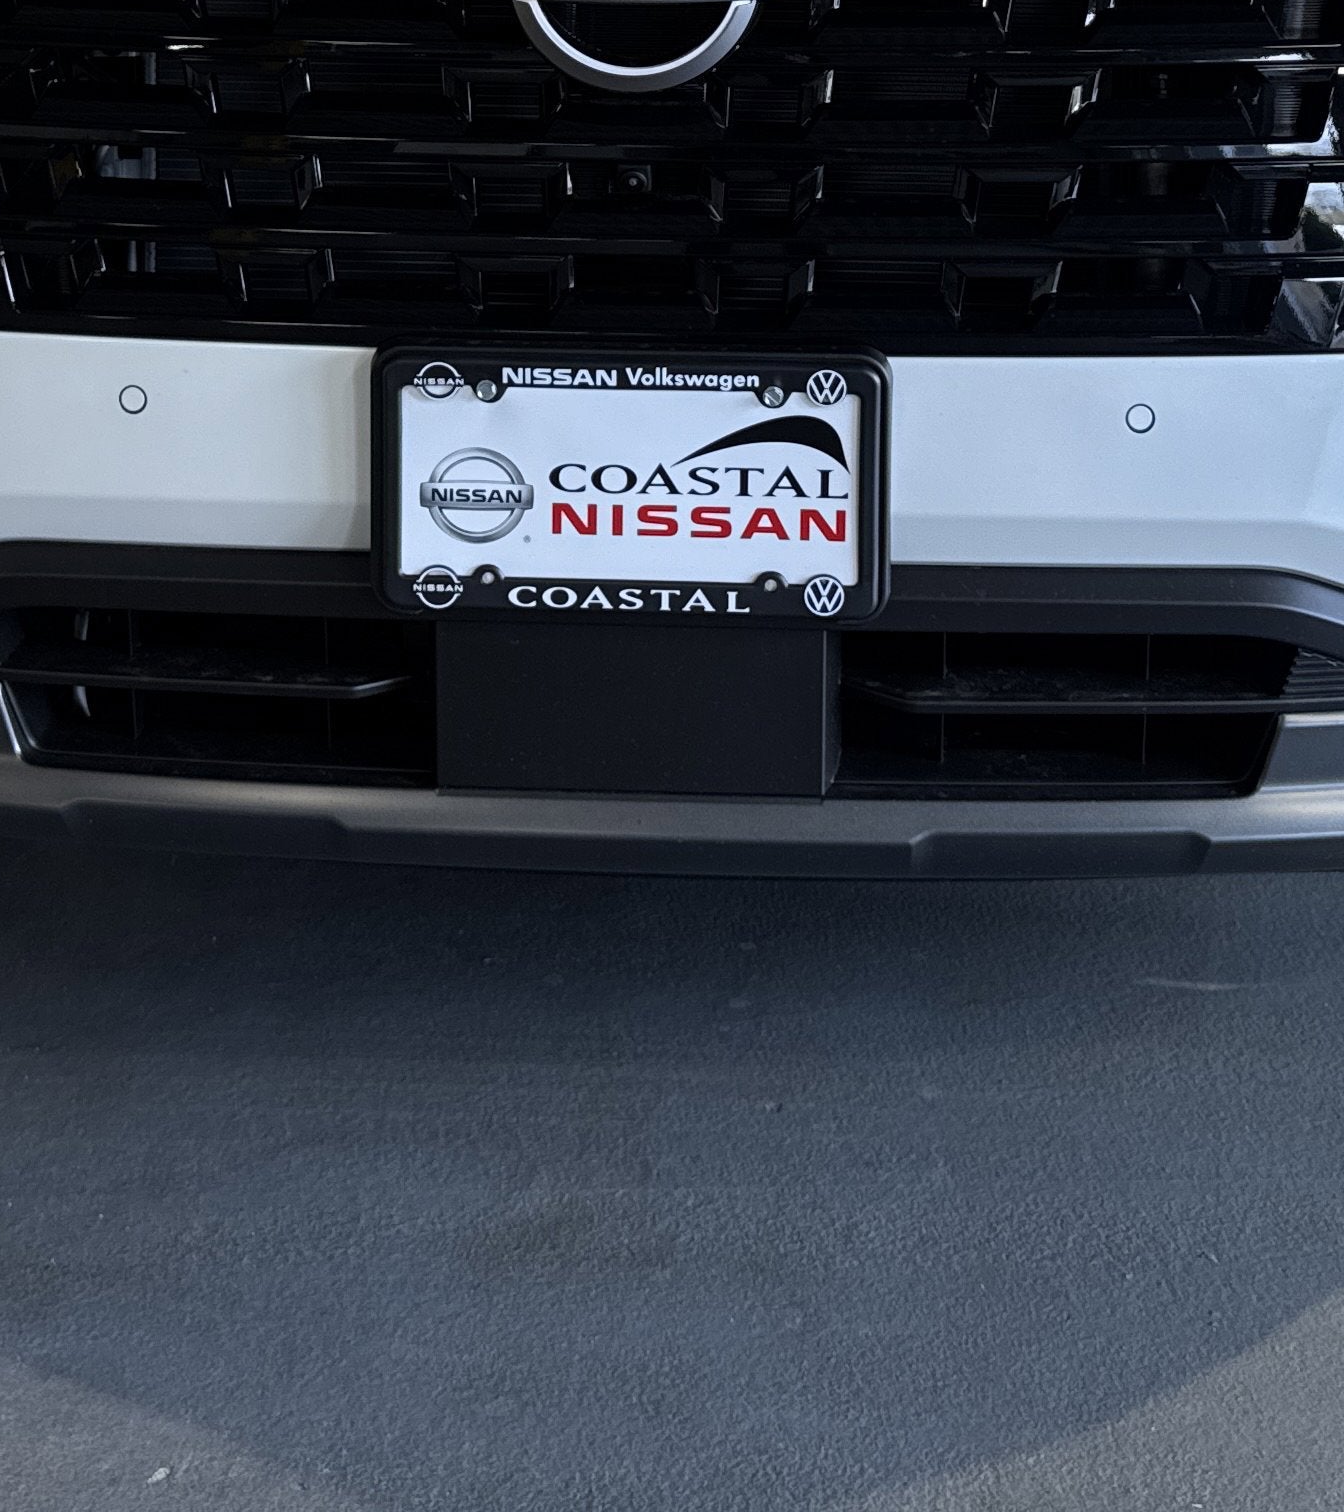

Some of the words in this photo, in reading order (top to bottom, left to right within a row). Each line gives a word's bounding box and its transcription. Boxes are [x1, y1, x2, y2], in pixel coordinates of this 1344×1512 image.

[413, 377, 465, 386] NISSAN
[501, 367, 618, 387] NISSAN
[625, 367, 760, 390] Volkswagen
[548, 463, 849, 500] COASTAL
[431, 487, 523, 504] NISSAN
[551, 503, 847, 543] NISSAN
[412, 583, 464, 592] NISSAN
[507, 585, 751, 613] COASTAL
